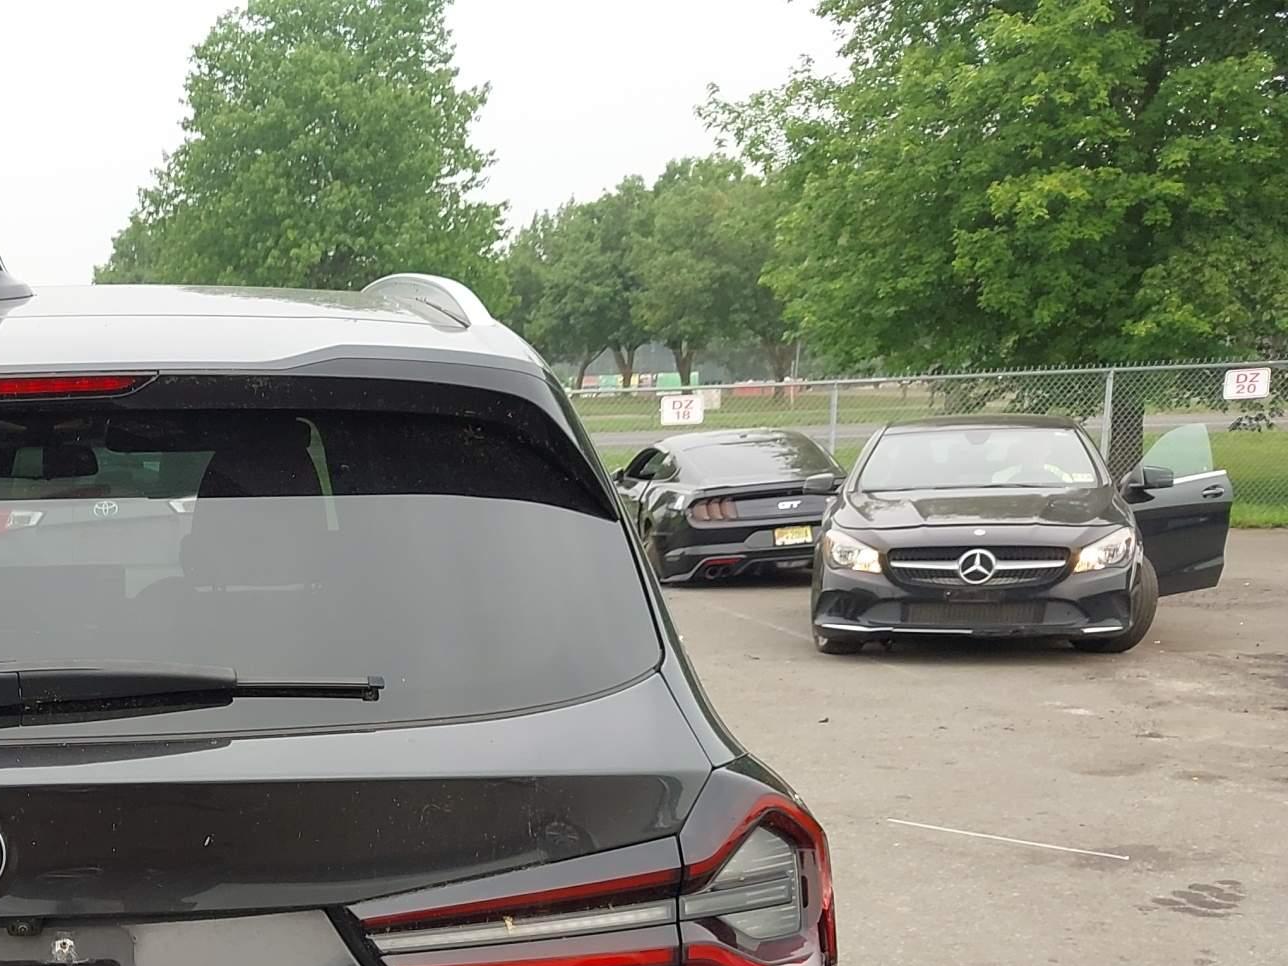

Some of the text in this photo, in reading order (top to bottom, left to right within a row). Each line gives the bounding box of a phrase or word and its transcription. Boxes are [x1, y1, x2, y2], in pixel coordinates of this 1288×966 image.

[1236, 372, 1261, 384] DZ
[1235, 383, 1257, 394] 20
[672, 399, 694, 410] DZ
[675, 410, 691, 420] 18
[777, 500, 802, 510] GT
